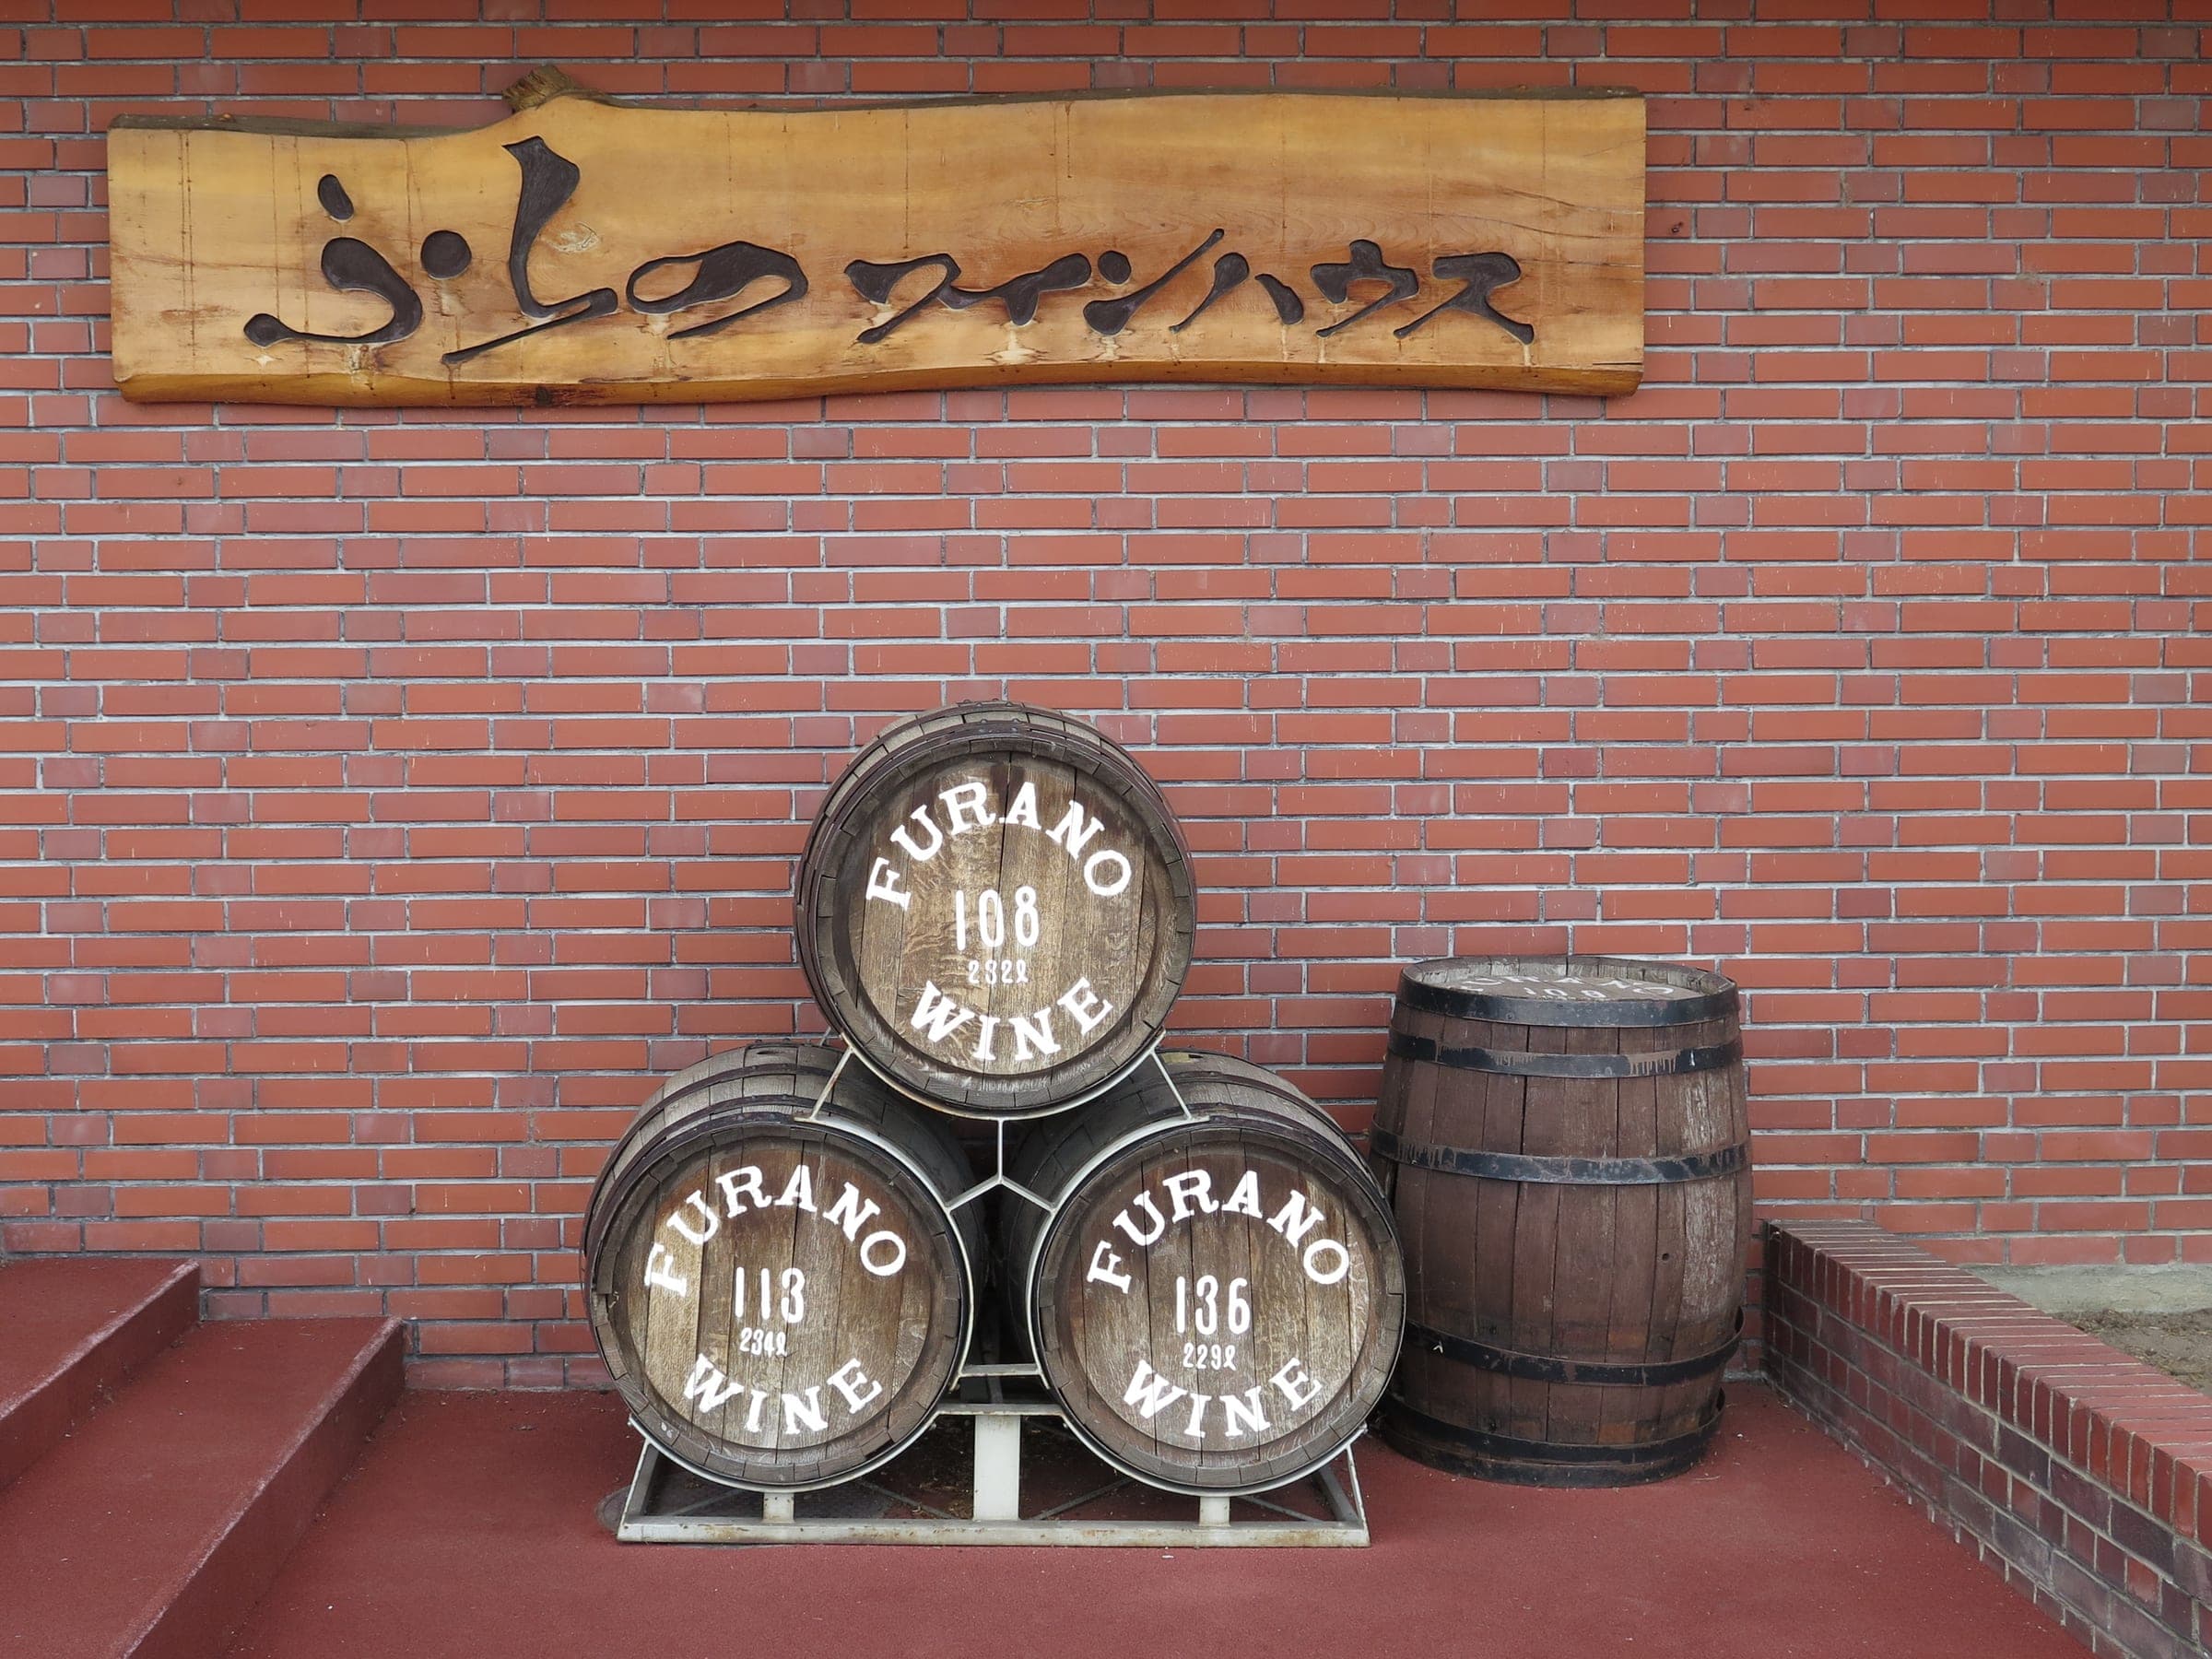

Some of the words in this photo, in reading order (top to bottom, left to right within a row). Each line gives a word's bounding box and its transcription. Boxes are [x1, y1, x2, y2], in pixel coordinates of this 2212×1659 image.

[865, 781, 1133, 912] FURANO
[955, 886, 1040, 950] 108
[911, 976, 1114, 1062] WINE
[644, 1164, 907, 1299] FURANO
[1087, 1168, 1349, 1294] FURANO
[735, 1266, 806, 1324] 113
[1176, 1274, 1251, 1335] 136
[683, 1353, 883, 1435] WINE
[1123, 1357, 1324, 1438] WINE
